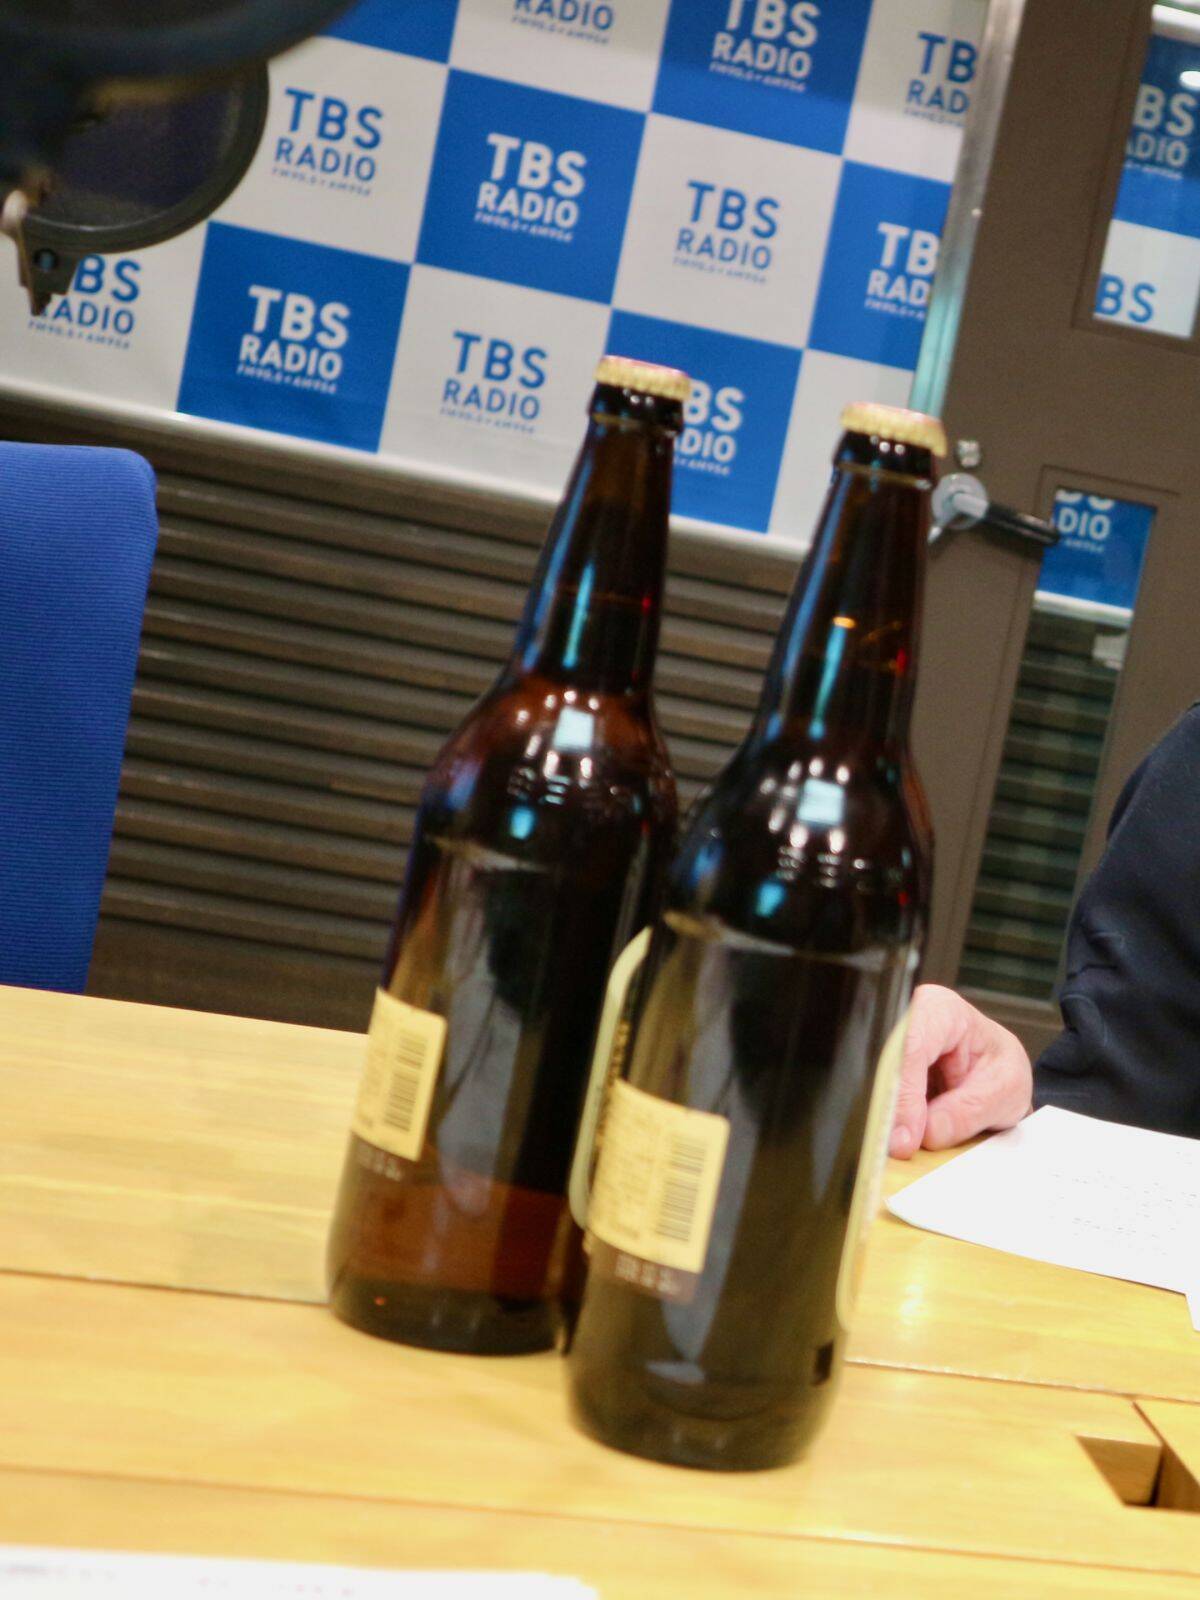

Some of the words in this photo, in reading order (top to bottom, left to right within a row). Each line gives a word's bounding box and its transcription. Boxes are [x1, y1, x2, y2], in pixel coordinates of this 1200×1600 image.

[712, 31, 811, 79] RADIO
[284, 87, 384, 150] TBS
[275, 136, 377, 182] RADIO
[487, 132, 587, 198] TBS
[477, 180, 579, 228] RADIO
[687, 179, 780, 239] TBS
[677, 227, 772, 270] RADIO
[42, 296, 135, 335] ADIO
[248, 284, 350, 350] TBS
[239, 333, 343, 381] RADIO
[452, 330, 548, 389] TBS
[442, 378, 540, 421] RADIO
[674, 427, 737, 463] DIO
[1050, 506, 1112, 541] DIO
